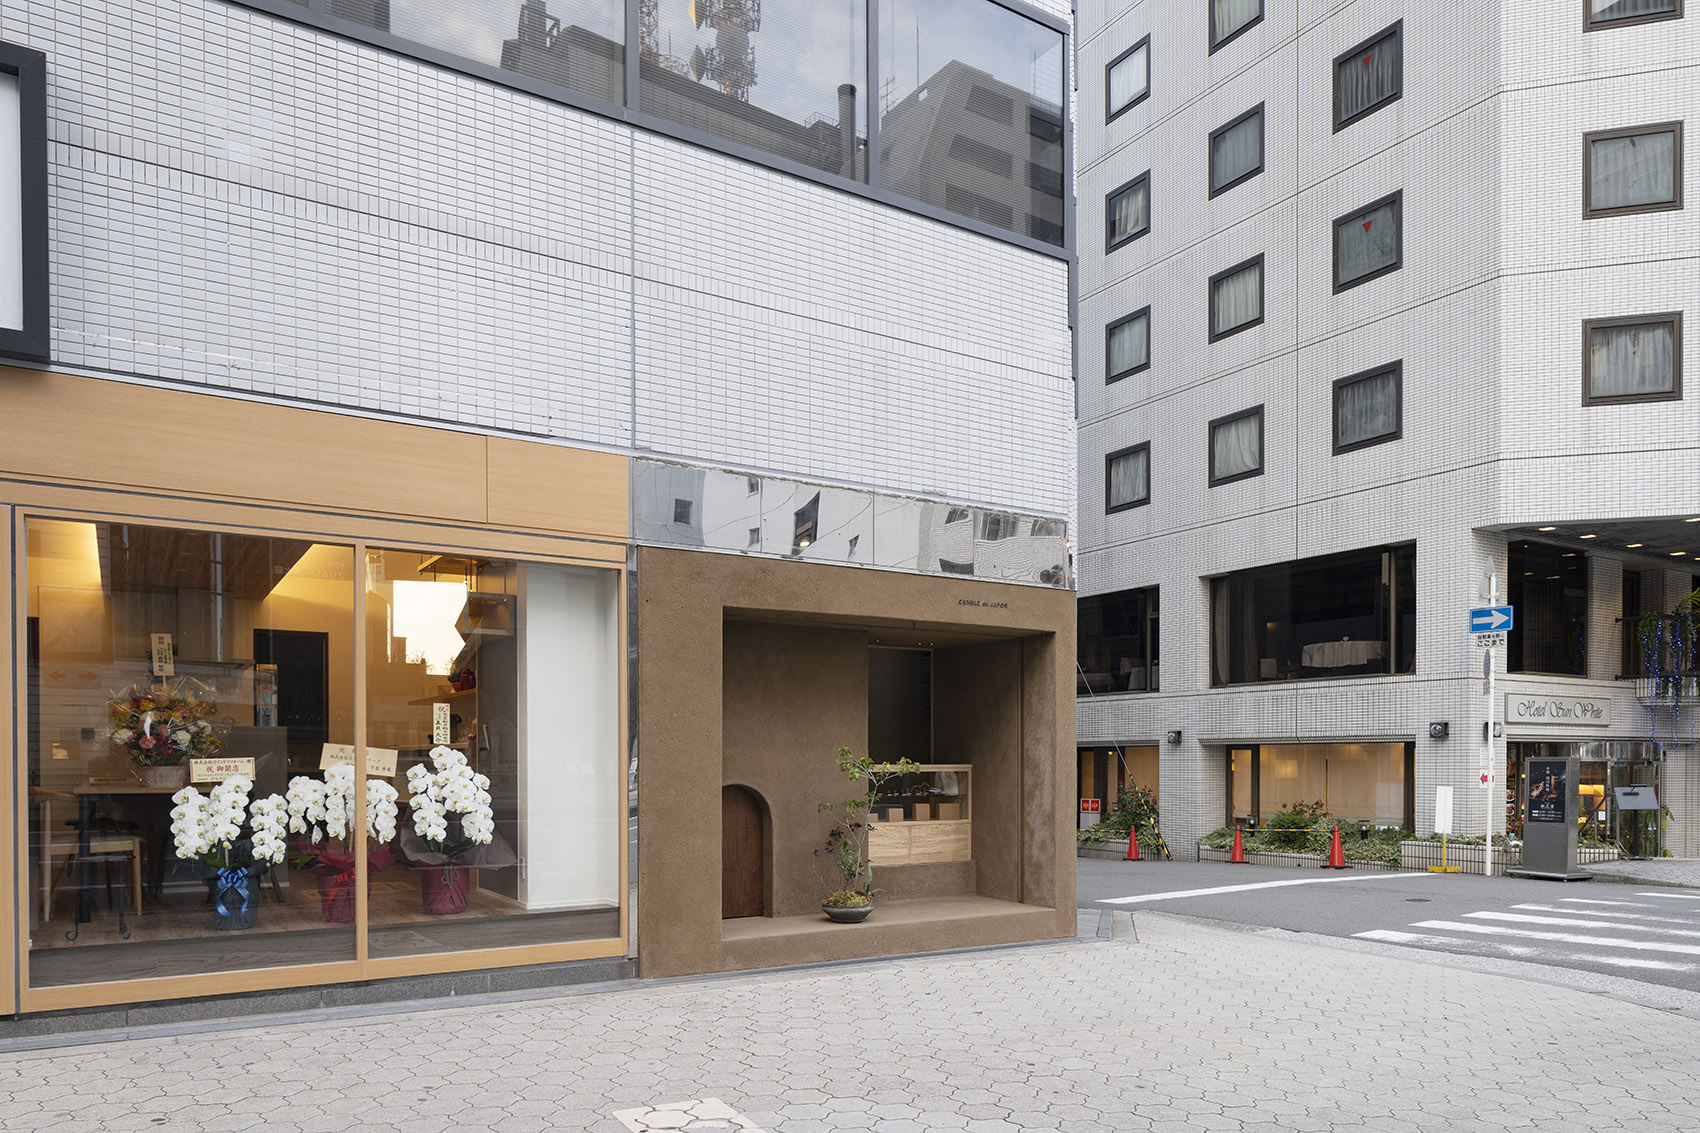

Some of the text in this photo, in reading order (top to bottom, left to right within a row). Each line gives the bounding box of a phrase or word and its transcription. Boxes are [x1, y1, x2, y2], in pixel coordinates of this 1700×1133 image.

[1477, 638, 1505, 647] ここまで
[1517, 700, 1603, 719] Hotel Sun White
